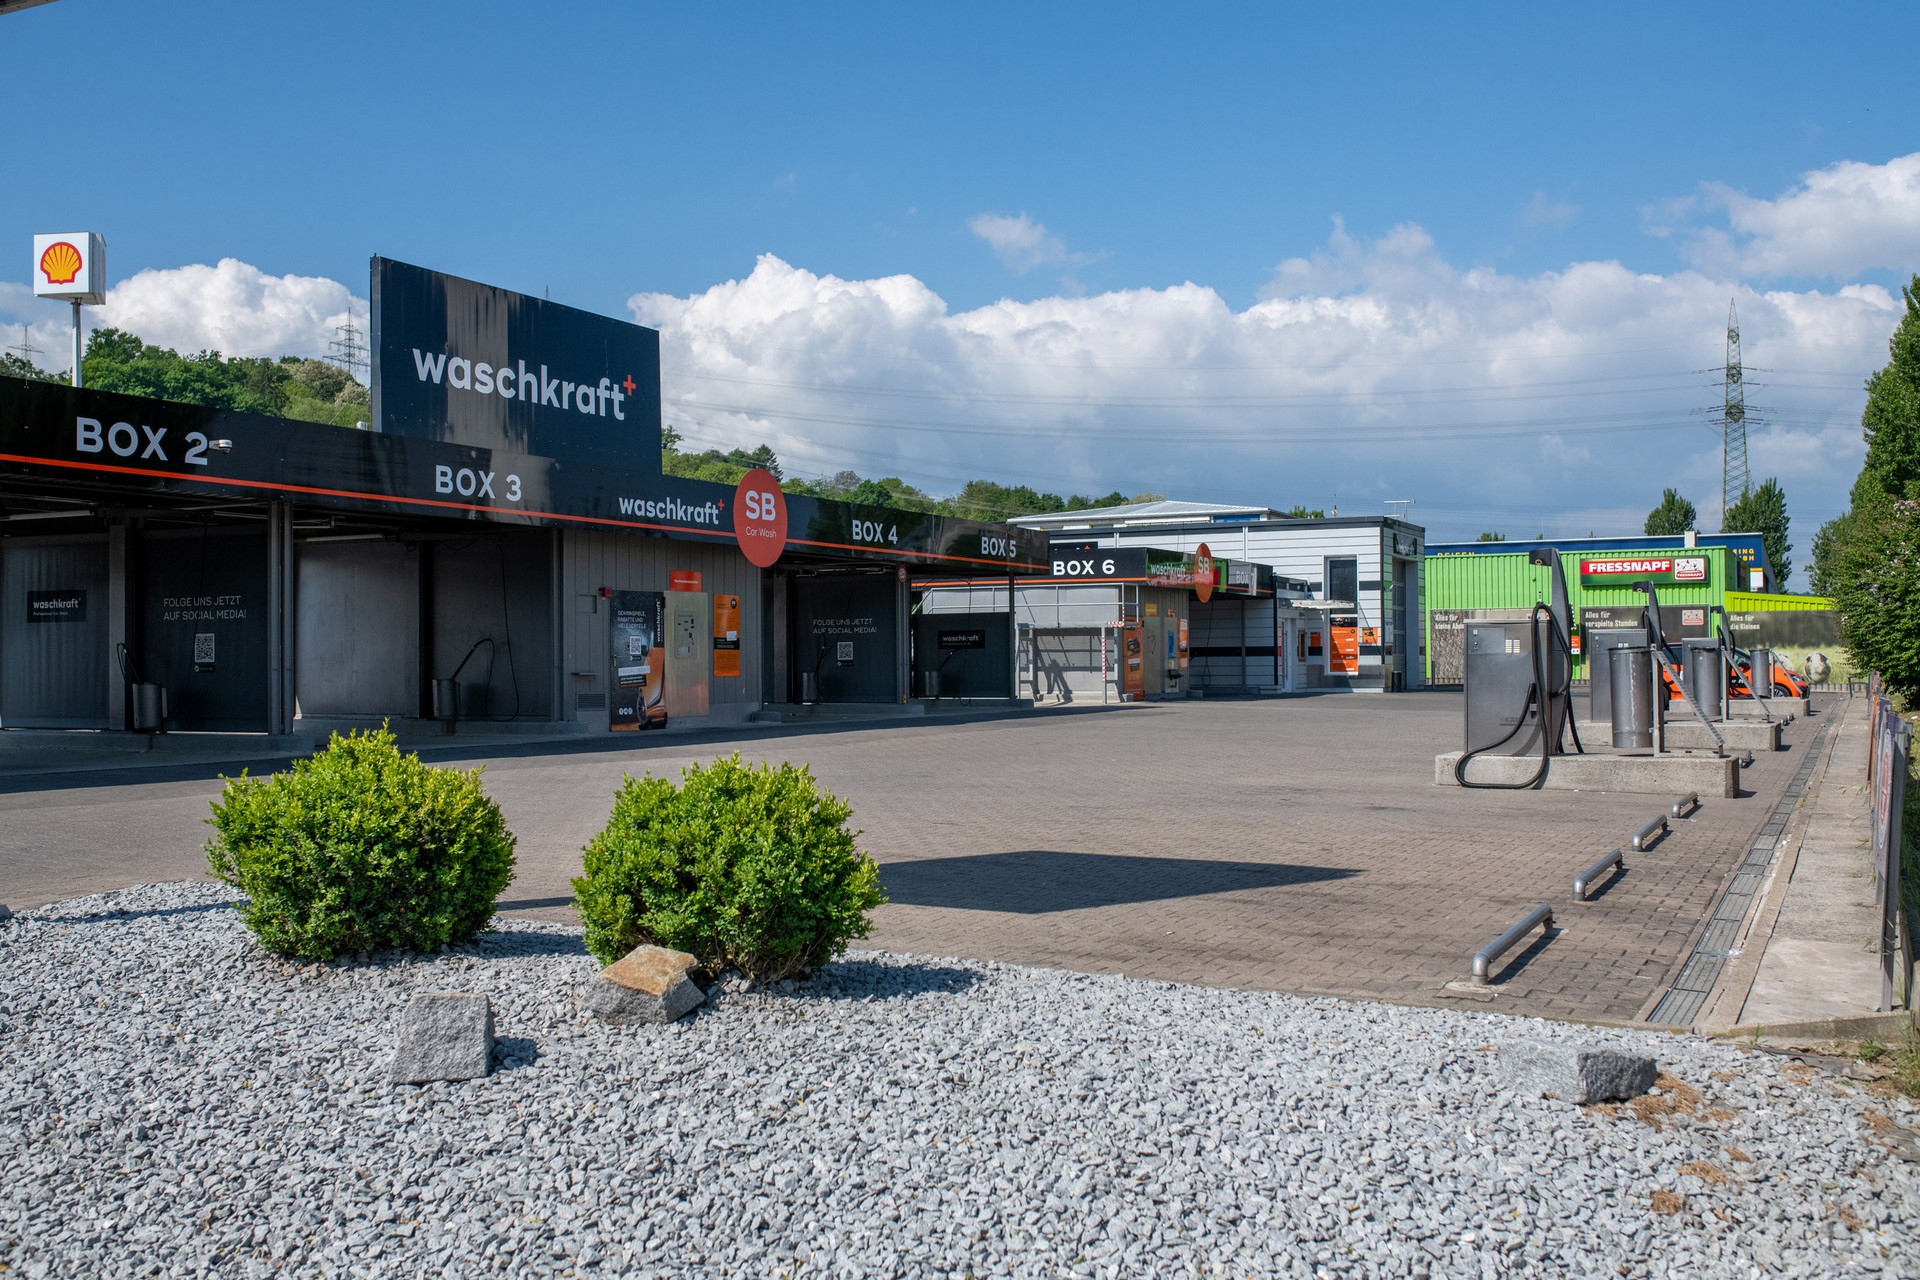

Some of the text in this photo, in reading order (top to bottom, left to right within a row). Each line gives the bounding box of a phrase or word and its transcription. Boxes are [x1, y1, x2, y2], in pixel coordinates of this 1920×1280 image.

[76, 416, 208, 465] BOX 2
[435, 464, 522, 502] BOX 3
[745, 490, 776, 521] SB
[745, 526, 777, 539] Car Wash
[852, 519, 898, 544] BOX 4
[981, 536, 1017, 558] BOX 5
[1053, 559, 1115, 576] BOX 6
[1198, 556, 1210, 574] SB
[1588, 560, 1670, 573] FRESSNAPF
[1236, 571, 1249, 584] BOX
[163, 595, 242, 607] FOLGE UNS JETZT
[163, 609, 247, 621] AUF SOCIAL MEDIA!
[1585, 619, 1638, 628] verspielte Stunden
